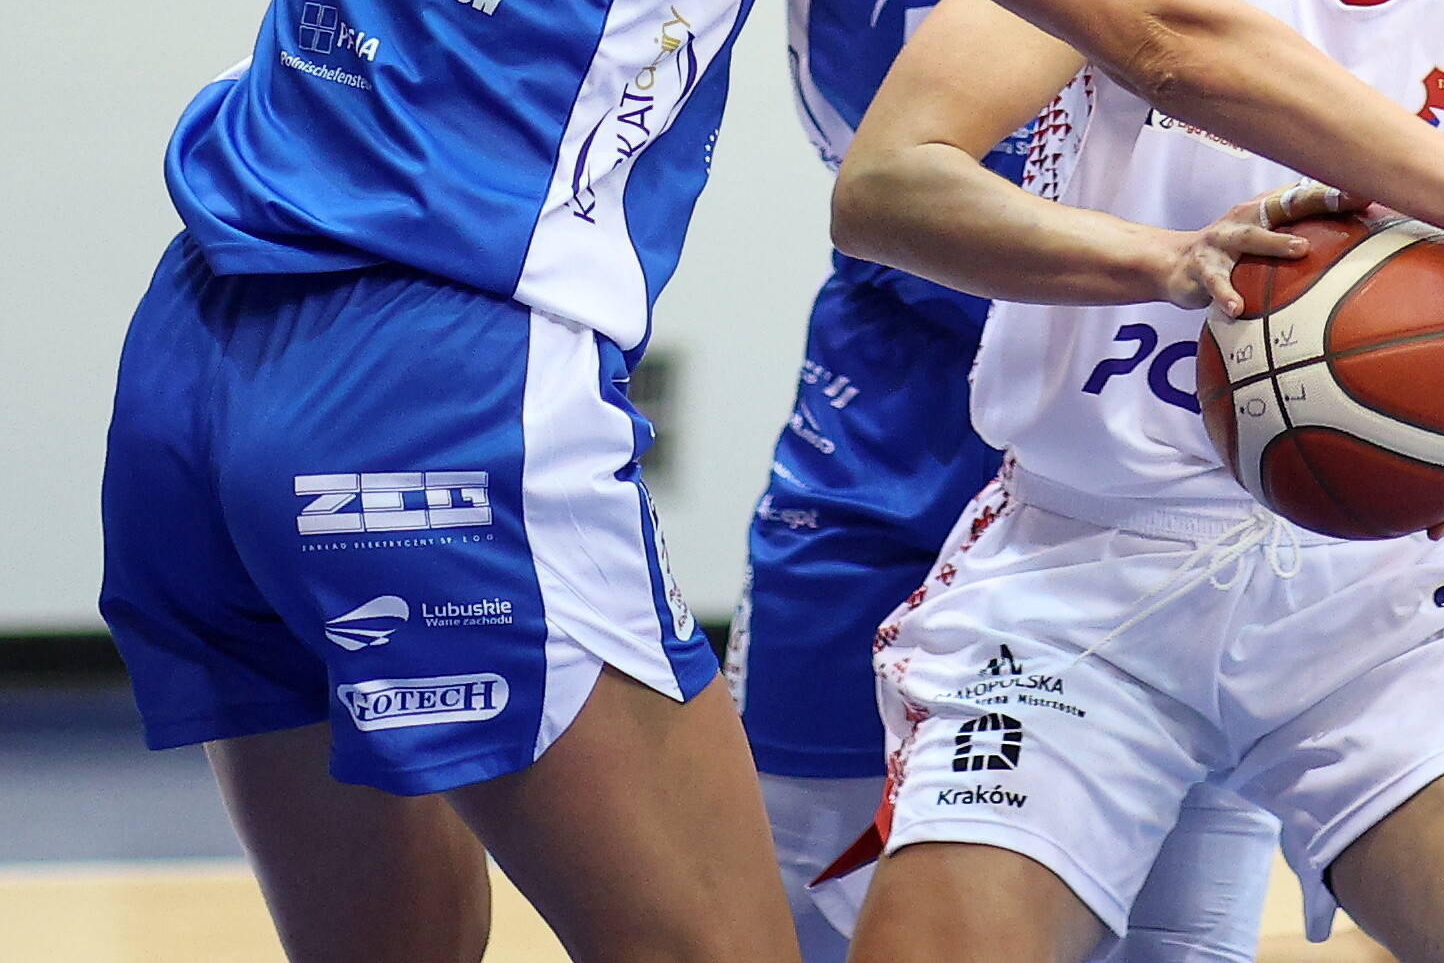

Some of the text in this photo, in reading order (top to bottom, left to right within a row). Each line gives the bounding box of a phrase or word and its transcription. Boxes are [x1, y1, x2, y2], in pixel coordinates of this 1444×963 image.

[422, 597, 512, 618] Lubuskie
[463, 614, 513, 626] zachodu
[934, 674, 1065, 701] AŁOPOLSKA
[936, 785, 1028, 809] Kraków
